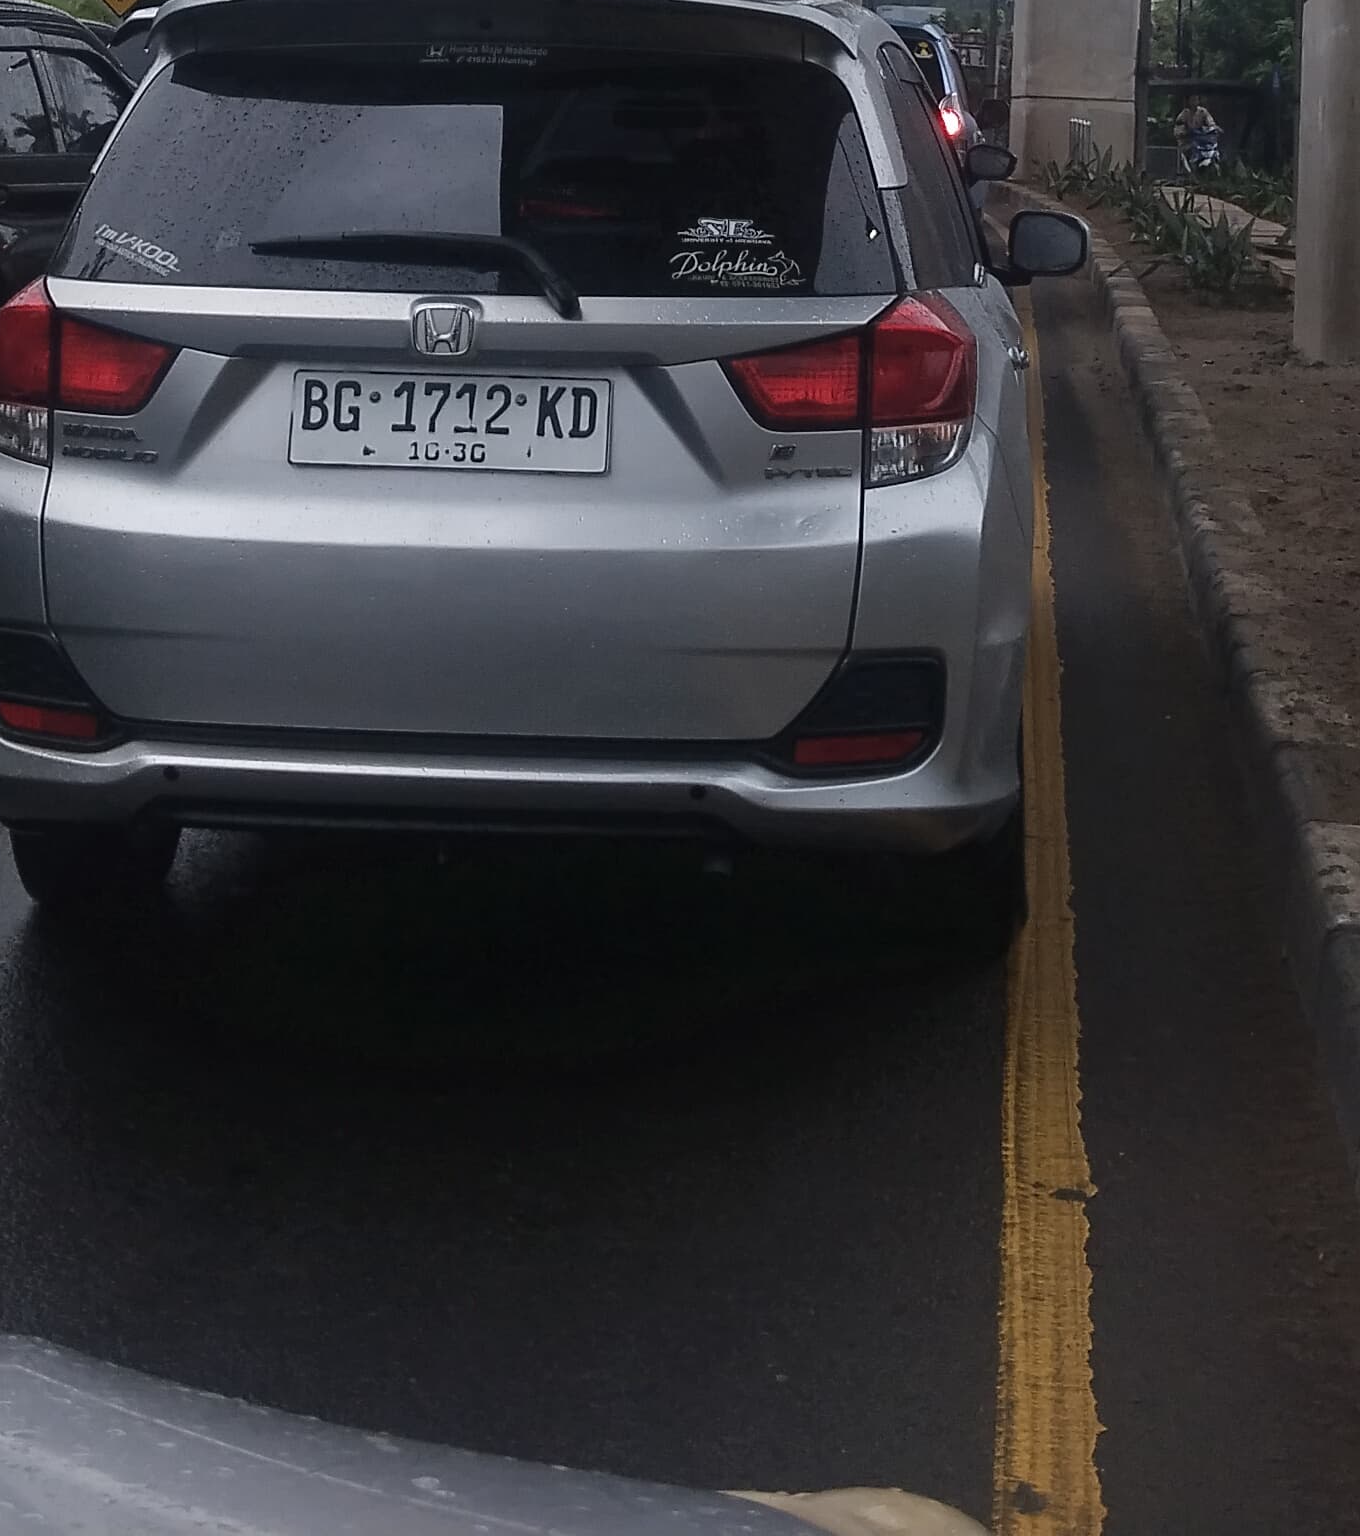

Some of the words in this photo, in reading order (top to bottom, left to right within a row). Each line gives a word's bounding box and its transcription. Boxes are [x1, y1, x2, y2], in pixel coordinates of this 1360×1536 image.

[669, 249, 778, 280] Dolphin
[301, 379, 361, 431] BG
[391, 381, 512, 435] 1712
[536, 385, 598, 439] KD
